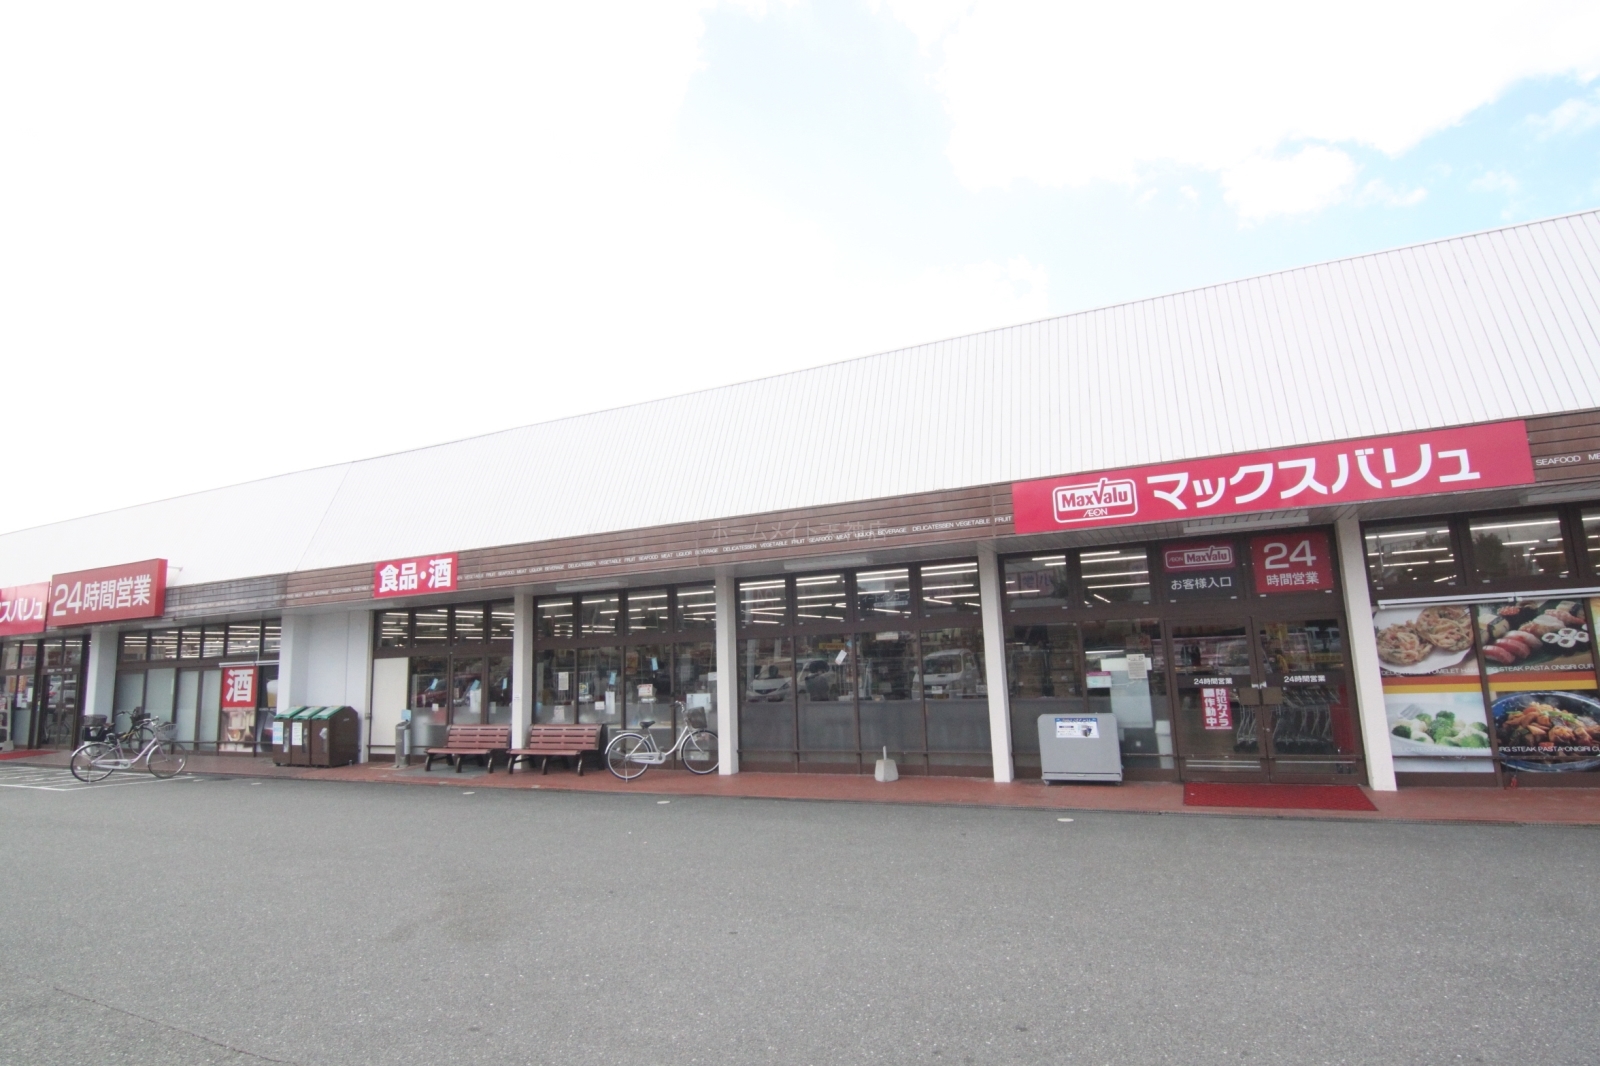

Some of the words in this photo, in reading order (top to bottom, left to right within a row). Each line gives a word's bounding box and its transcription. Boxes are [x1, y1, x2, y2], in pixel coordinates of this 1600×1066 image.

[1536, 455, 1581, 466] SEAFOOD
[1147, 443, 1481, 510] マックスバリュ
[1061, 480, 1128, 508] MaxValu
[723, 544, 757, 552] DELICATESSEN
[760, 540, 788, 548] VEGETABLE
[878, 527, 906, 536] BEVERAGE
[912, 522, 954, 532] DELICATESSEN
[956, 518, 990, 527] VEGETABLE
[1186, 545, 1228, 562] MaxValu
[1263, 540, 1316, 570] 24
[379, 558, 452, 592] 食品・酒
[1170, 576, 1232, 590] お客様入口
[1266, 571, 1320, 586] 時間営業
[52, 574, 152, 616] 24時間営業
[1525, 664, 1550, 672] PASTA
[1551, 663, 1577, 671] ONIGIRI
[226, 669, 254, 702] 酒
